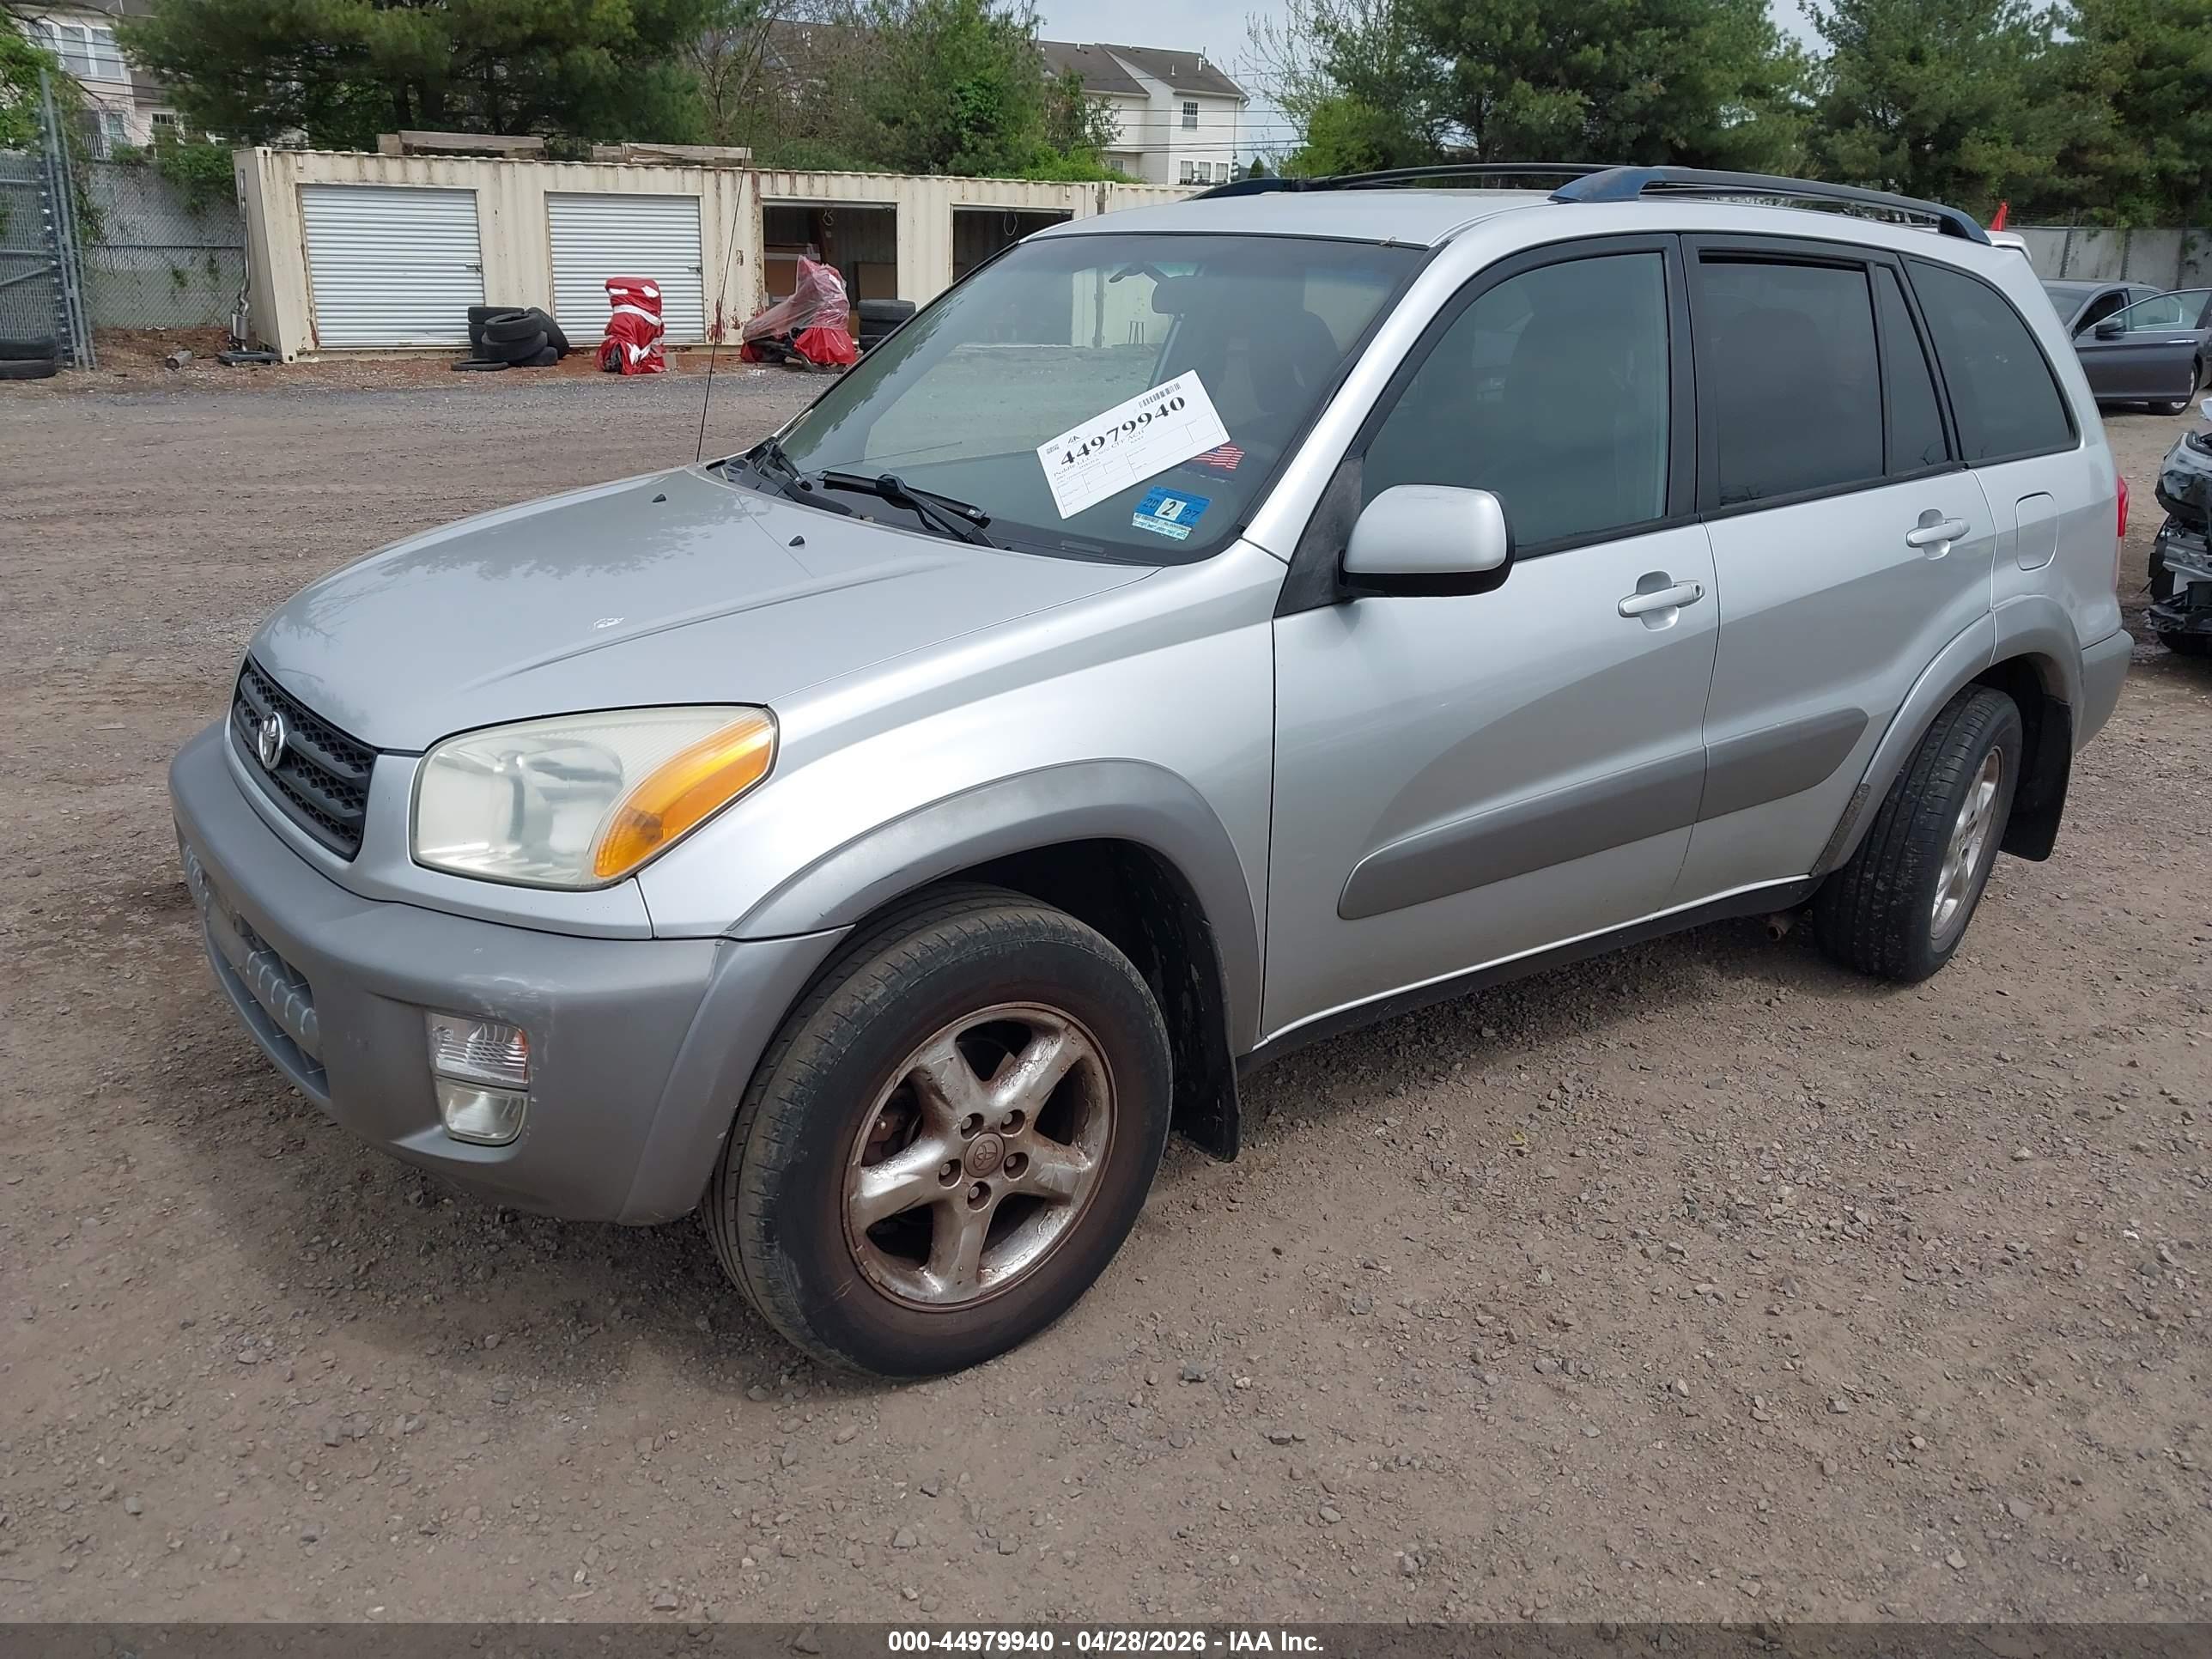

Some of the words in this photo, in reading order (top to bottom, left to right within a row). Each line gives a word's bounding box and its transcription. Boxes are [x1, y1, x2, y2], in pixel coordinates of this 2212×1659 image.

[1061, 397, 1184, 465] 44979940
[1142, 498, 1159, 508] 20
[1164, 501, 1176, 516] 2
[1183, 509, 1200, 520] 27
